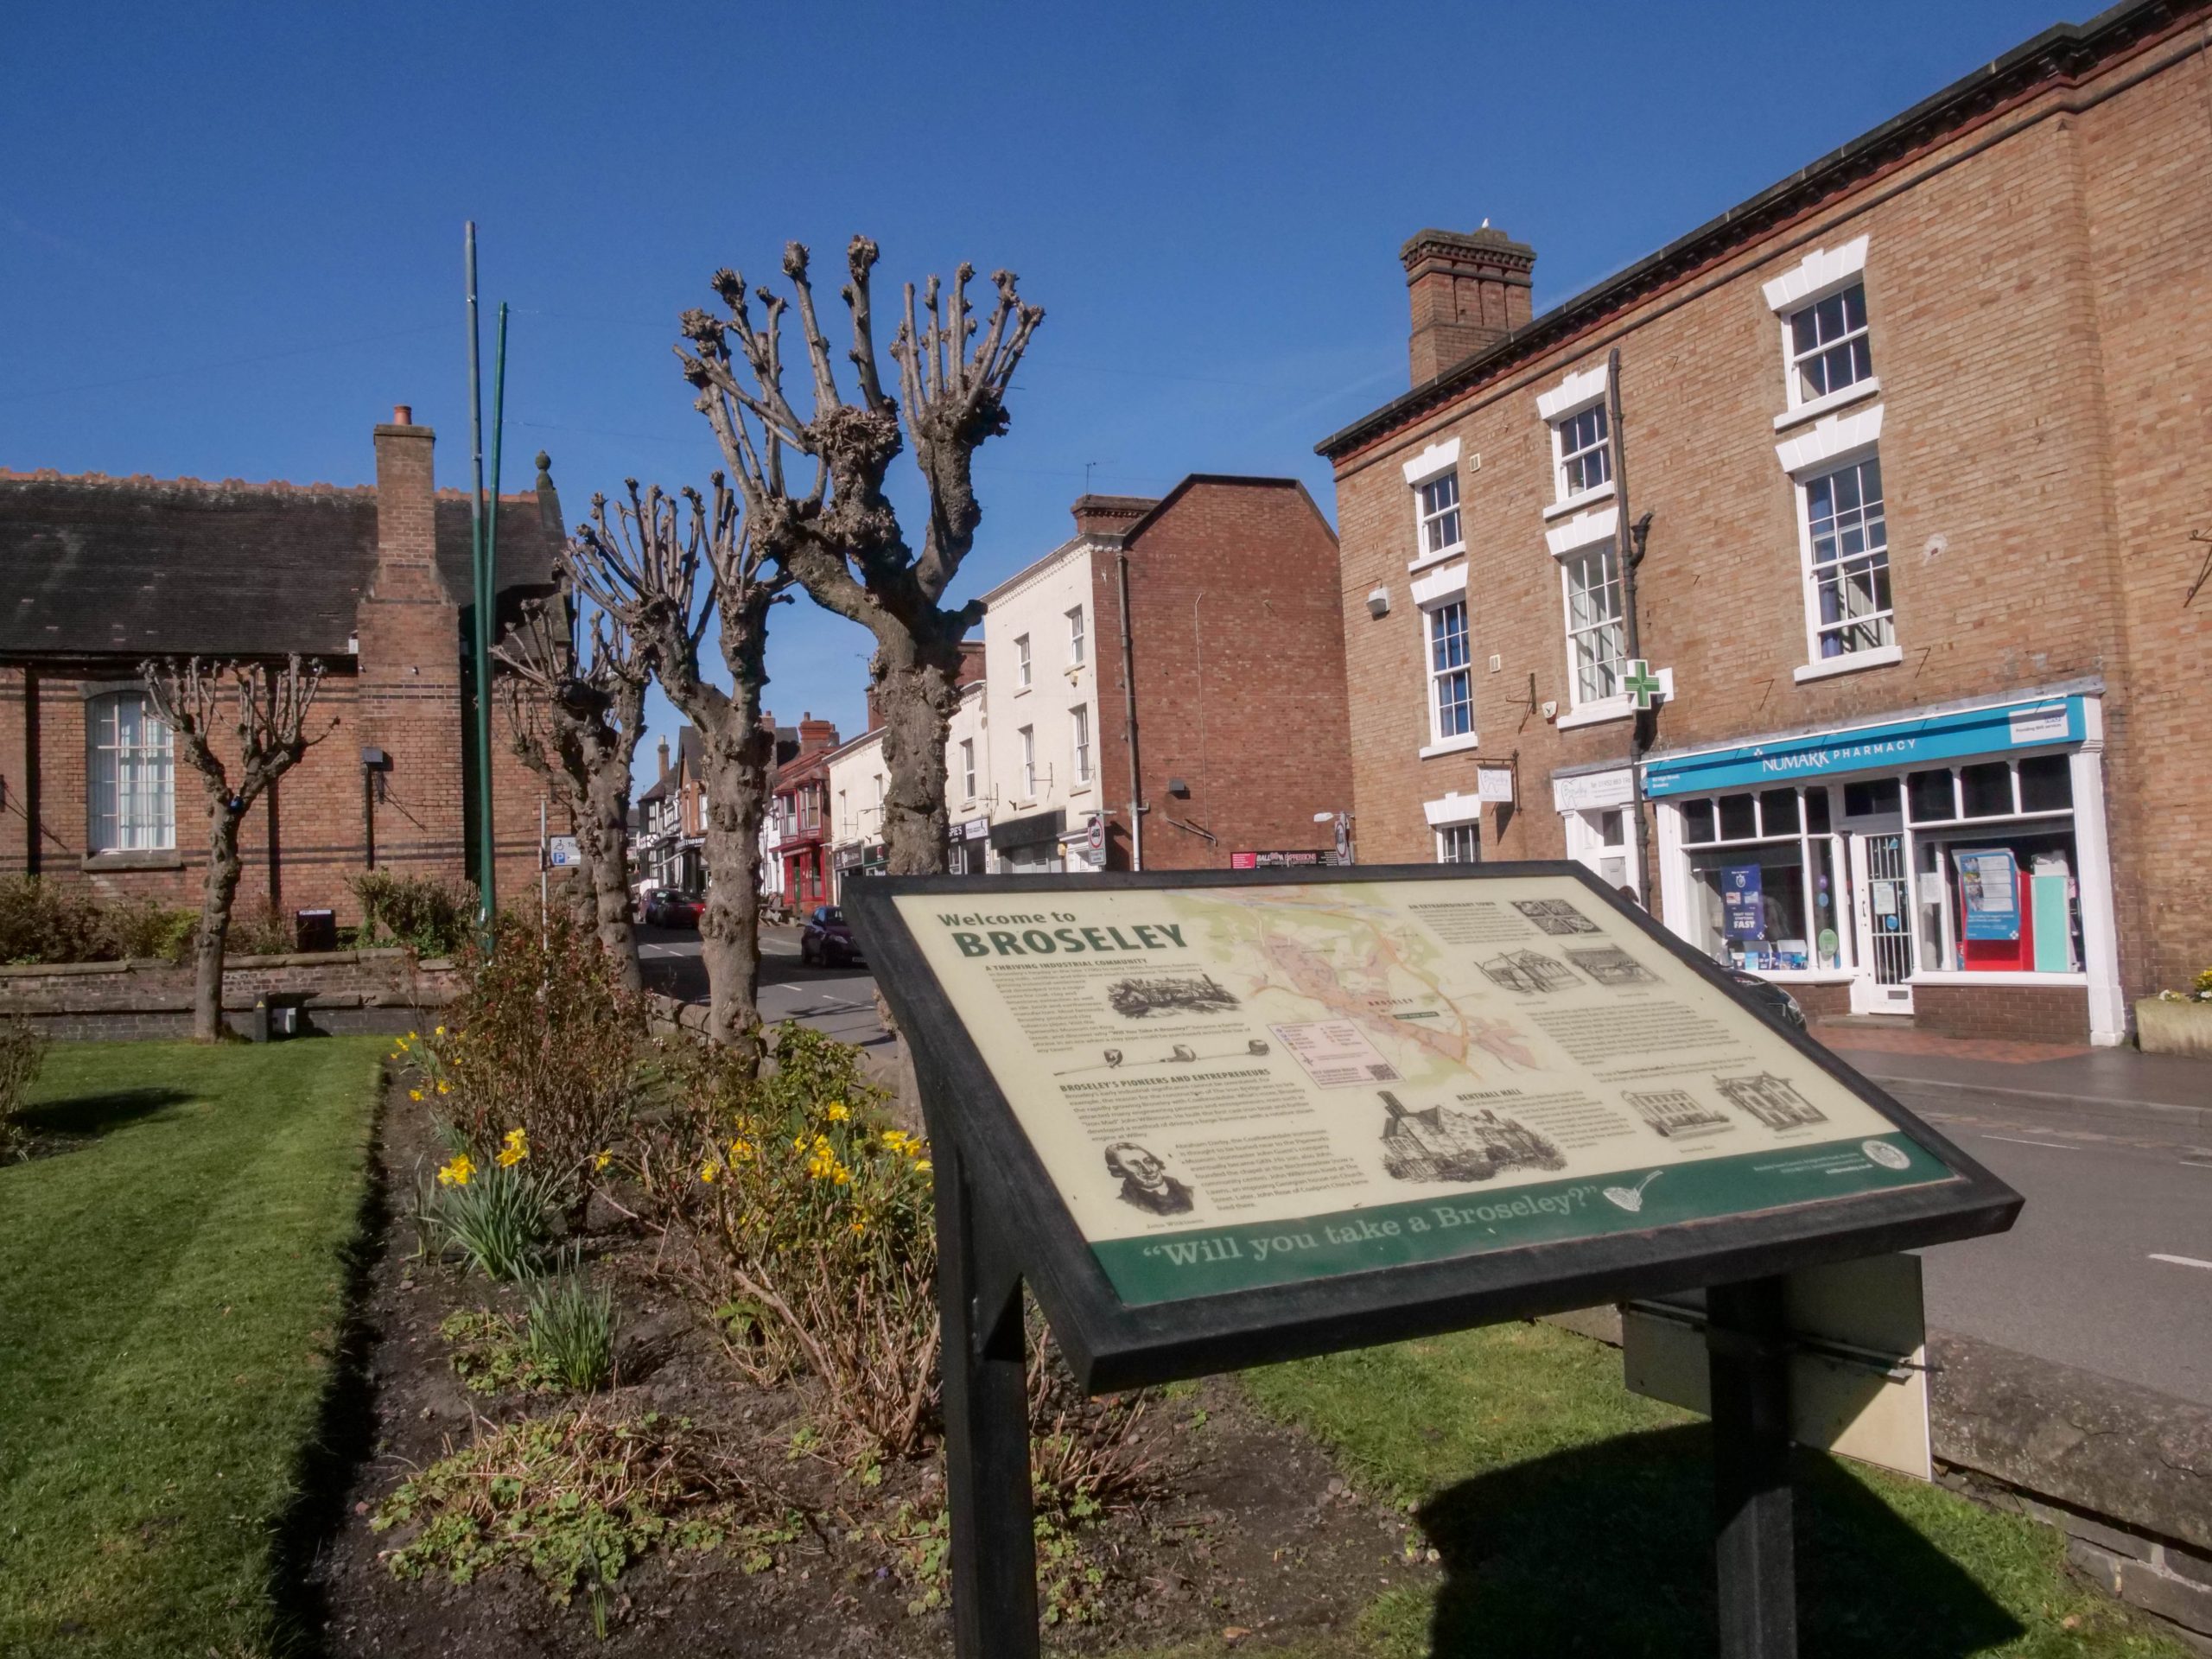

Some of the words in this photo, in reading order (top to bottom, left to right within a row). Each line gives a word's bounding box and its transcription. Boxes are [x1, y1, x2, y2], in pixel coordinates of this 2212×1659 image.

[1763, 749, 1829, 772] NUMARK
[1834, 739, 1916, 760] PHARMACY
[938, 912, 1047, 926] Welcome
[1052, 912, 1077, 924] to
[1733, 920, 1756, 929] FAST
[952, 924, 1187, 957] BROSELEY
[1058, 1080, 1119, 1092] BROSELEY'S
[1118, 1077, 1169, 1087] PIONEERS
[1170, 1074, 1192, 1083] AND
[1190, 1068, 1270, 1081] ENTREPRENEURS
[1455, 1090, 1503, 1101] BENTHALL
[1142, 1236, 1243, 1266] "Will
[1249, 1236, 1319, 1262] you
[1324, 1217, 1402, 1244] take
[1408, 1214, 1430, 1232] a
[1437, 1185, 1600, 1233] Broseley?"
